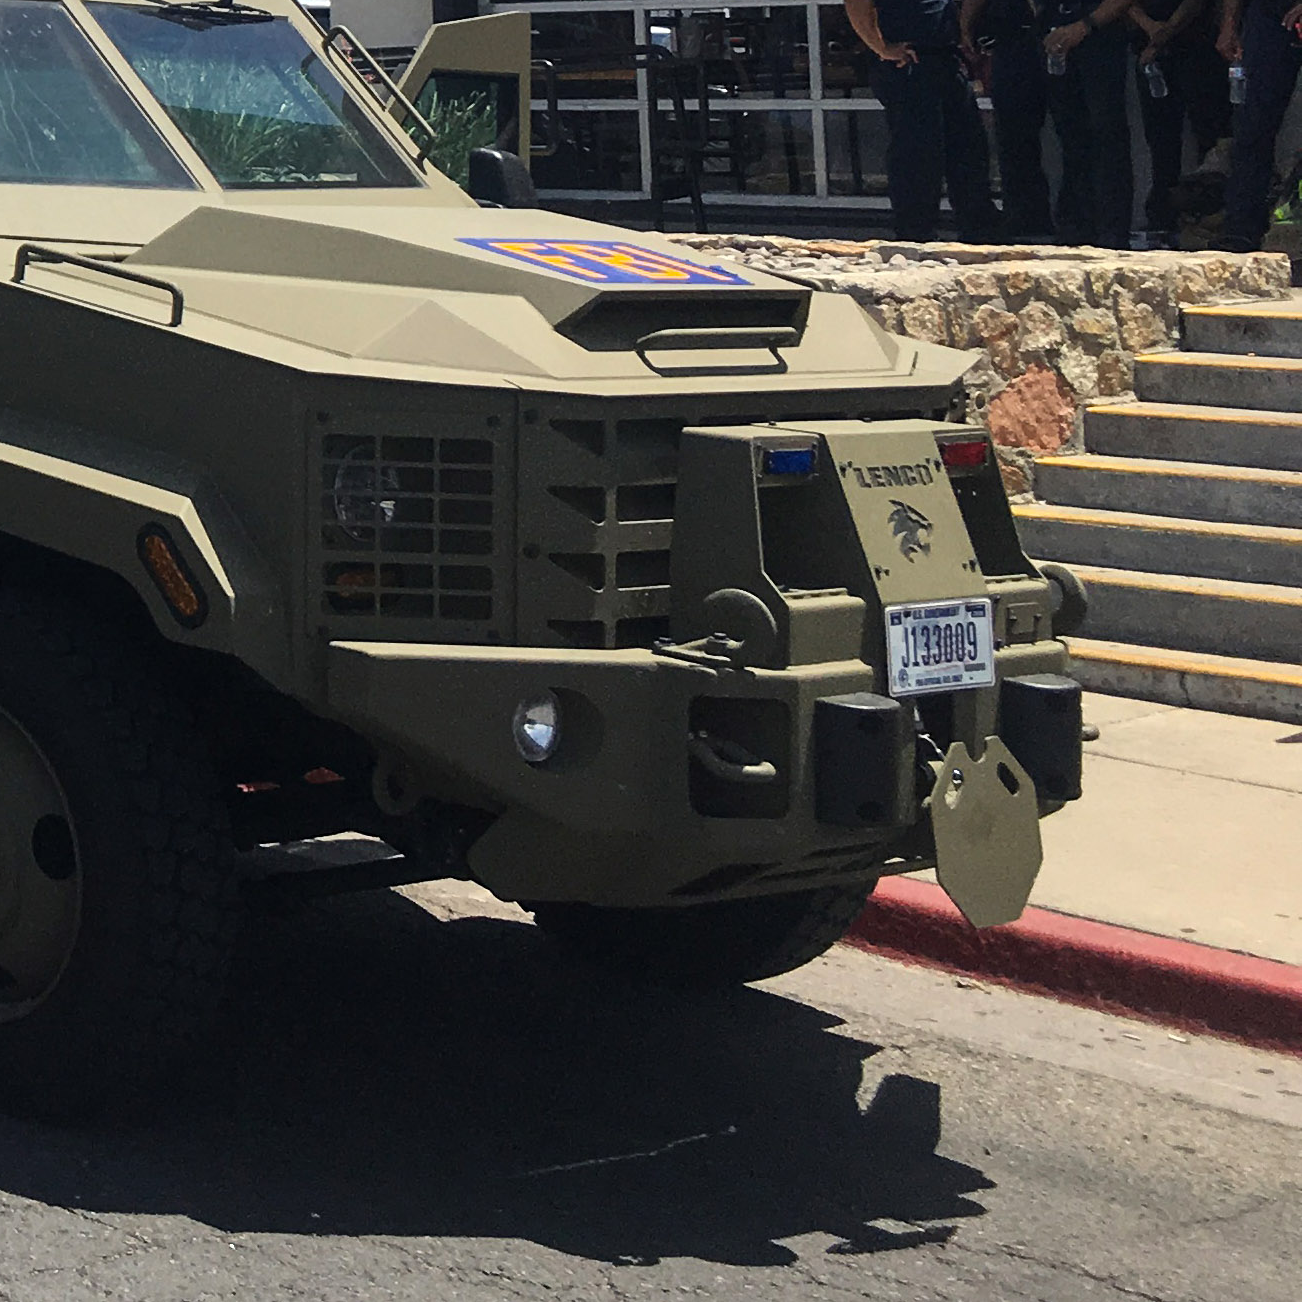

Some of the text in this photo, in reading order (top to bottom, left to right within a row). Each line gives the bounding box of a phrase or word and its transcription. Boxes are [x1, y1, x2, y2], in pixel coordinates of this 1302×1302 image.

[487, 241, 738, 282] FBI
[852, 464, 934, 488] LENCO
[901, 621, 978, 668] J133009
